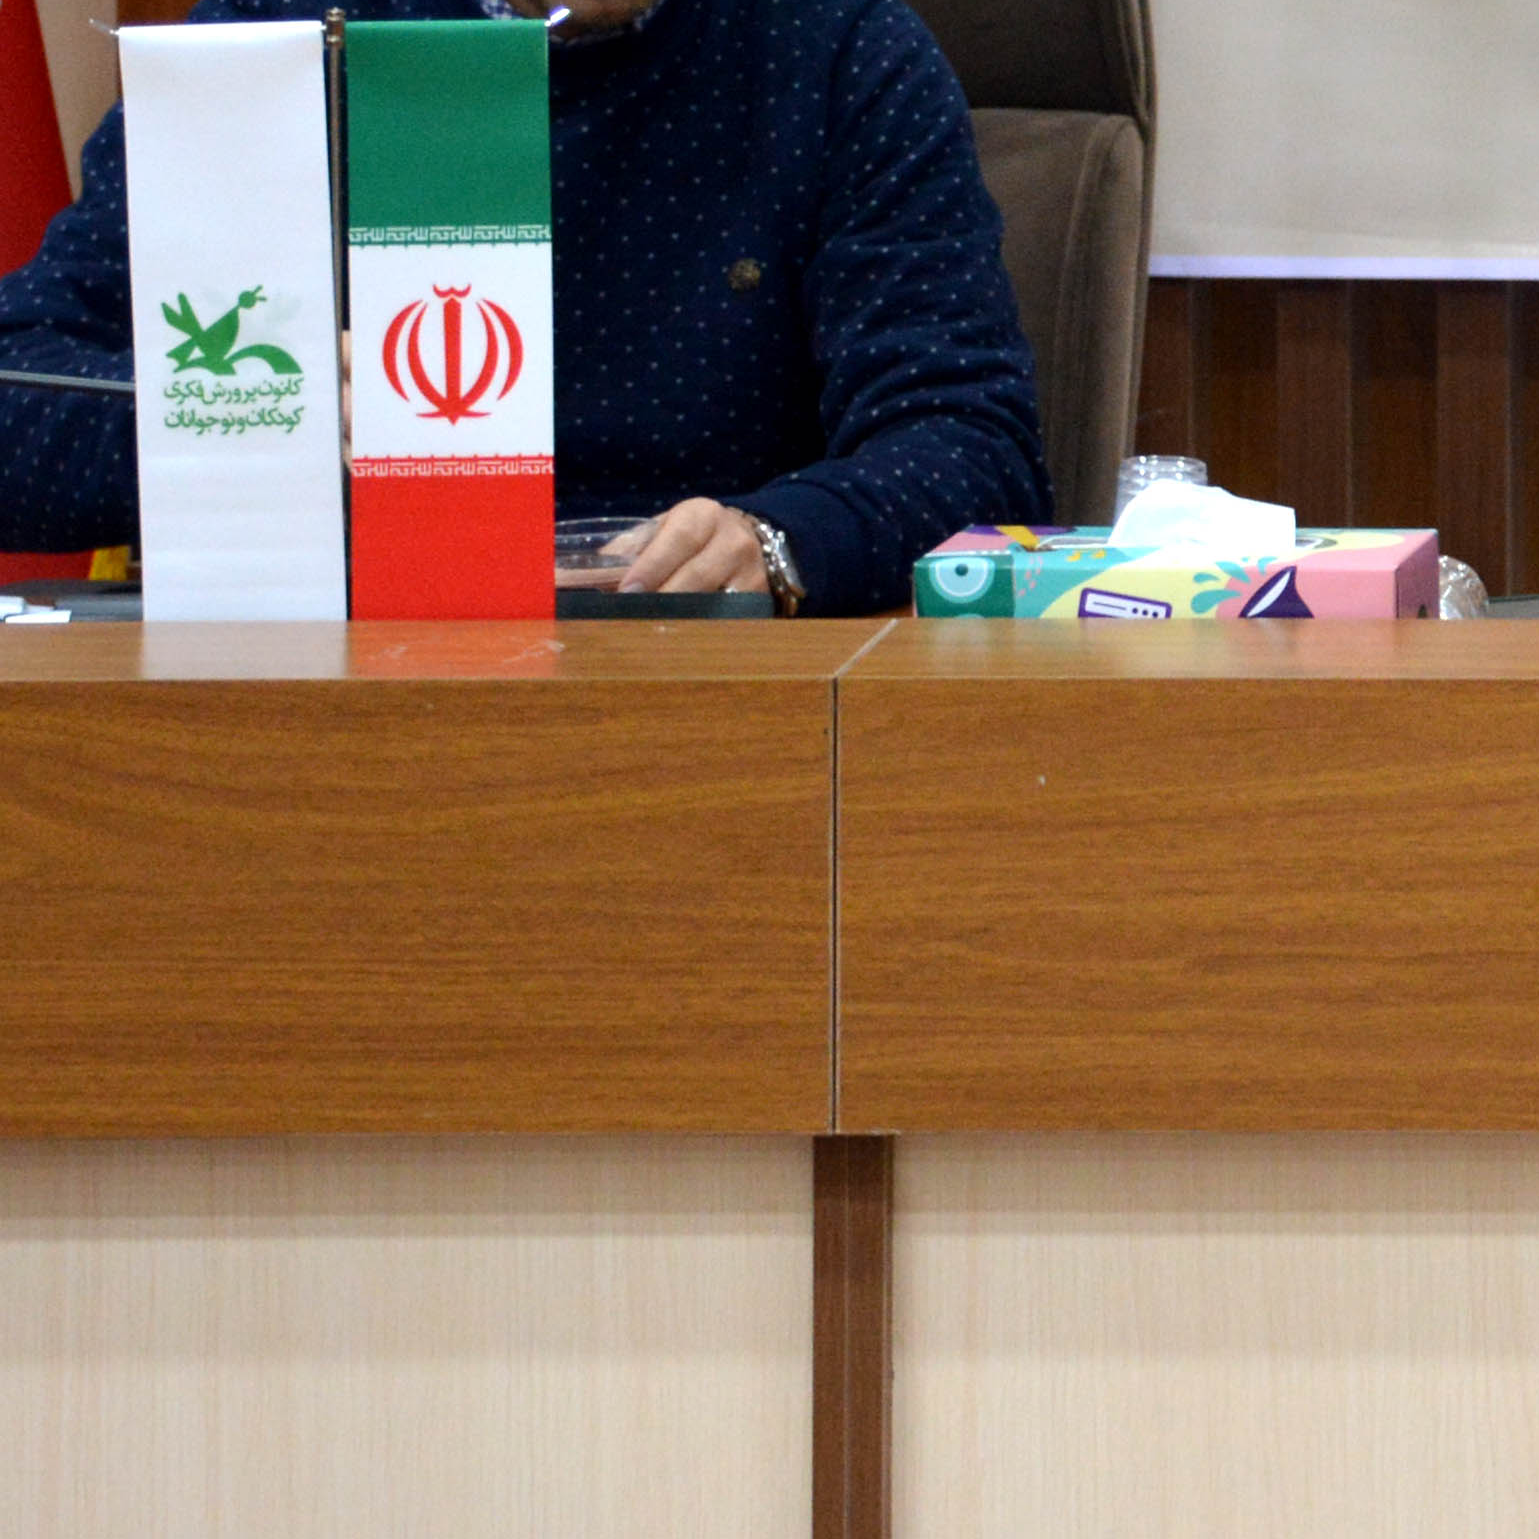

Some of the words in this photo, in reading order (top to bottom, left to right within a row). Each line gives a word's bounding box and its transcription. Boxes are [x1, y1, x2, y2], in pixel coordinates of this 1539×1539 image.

[163, 380, 204, 405] فکری
[202, 380, 259, 405] پرورش
[259, 377, 305, 403] کانون
[247, 406, 305, 434] کودکان
